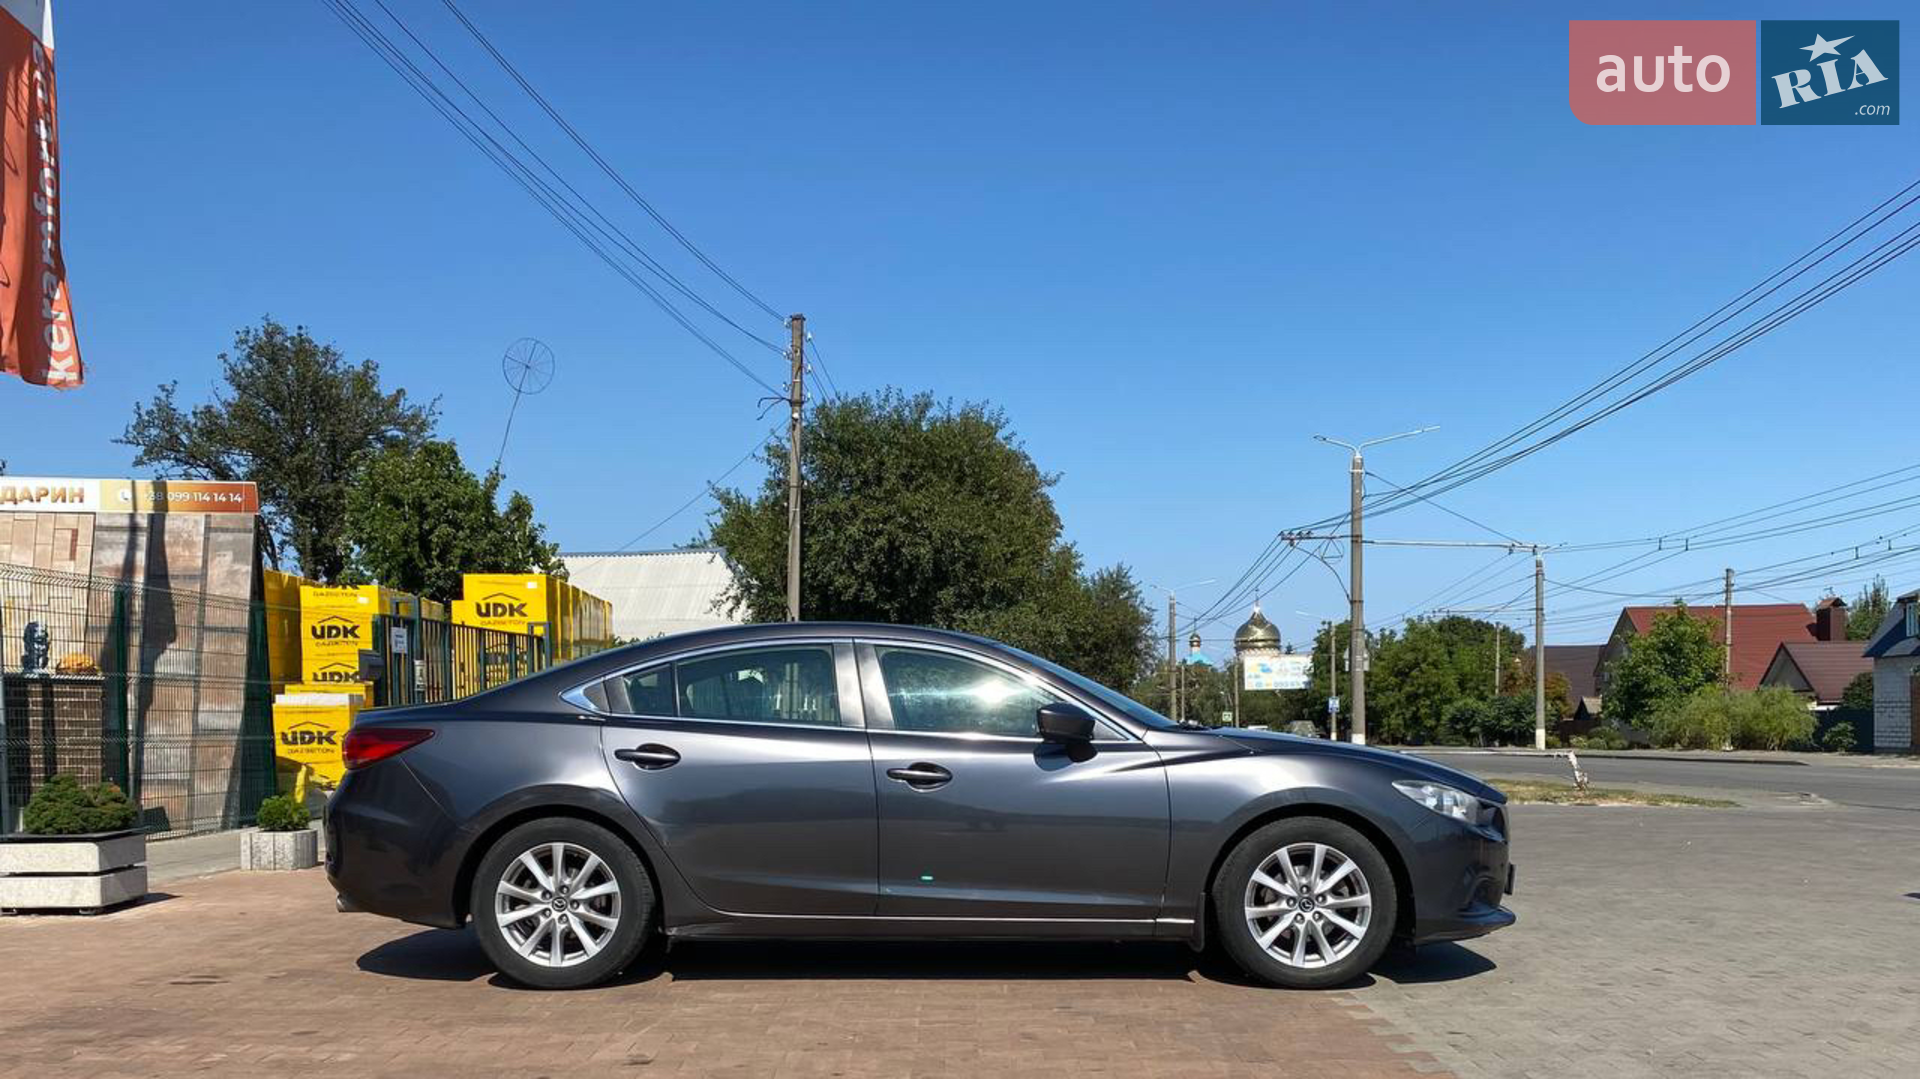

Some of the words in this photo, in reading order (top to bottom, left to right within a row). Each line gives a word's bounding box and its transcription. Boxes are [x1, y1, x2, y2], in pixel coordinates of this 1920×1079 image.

[167, 491, 190, 501] 099
[193, 491, 211, 502] 114
[214, 493, 226, 502] 14
[229, 493, 242, 503] 14
[475, 602, 529, 618] UDK
[311, 625, 360, 639] UDK
[312, 671, 360, 682] UDK
[281, 730, 337, 745] UDK
